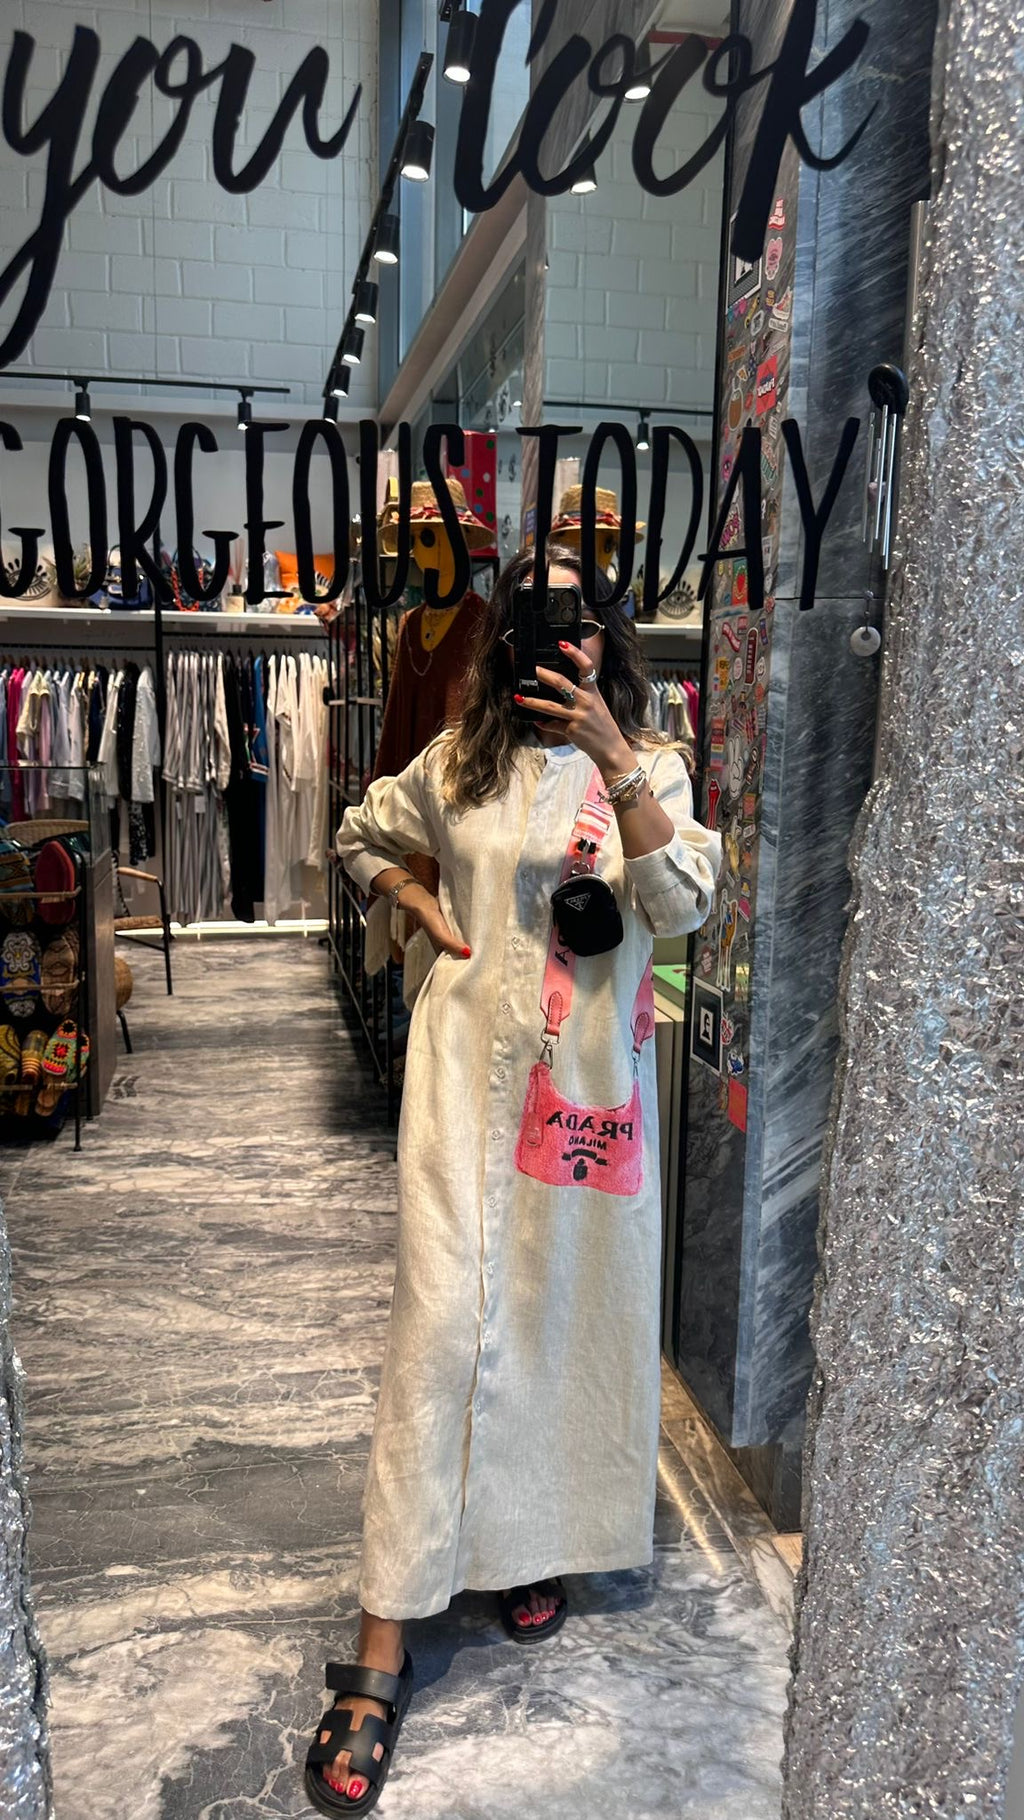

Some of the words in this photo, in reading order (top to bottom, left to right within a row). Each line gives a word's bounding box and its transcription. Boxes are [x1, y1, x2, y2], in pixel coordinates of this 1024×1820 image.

[0, 24, 362, 370] you
[453, 0, 880, 263] look
[0, 417, 471, 609] GORGEOUS
[515, 417, 861, 612] TODAY
